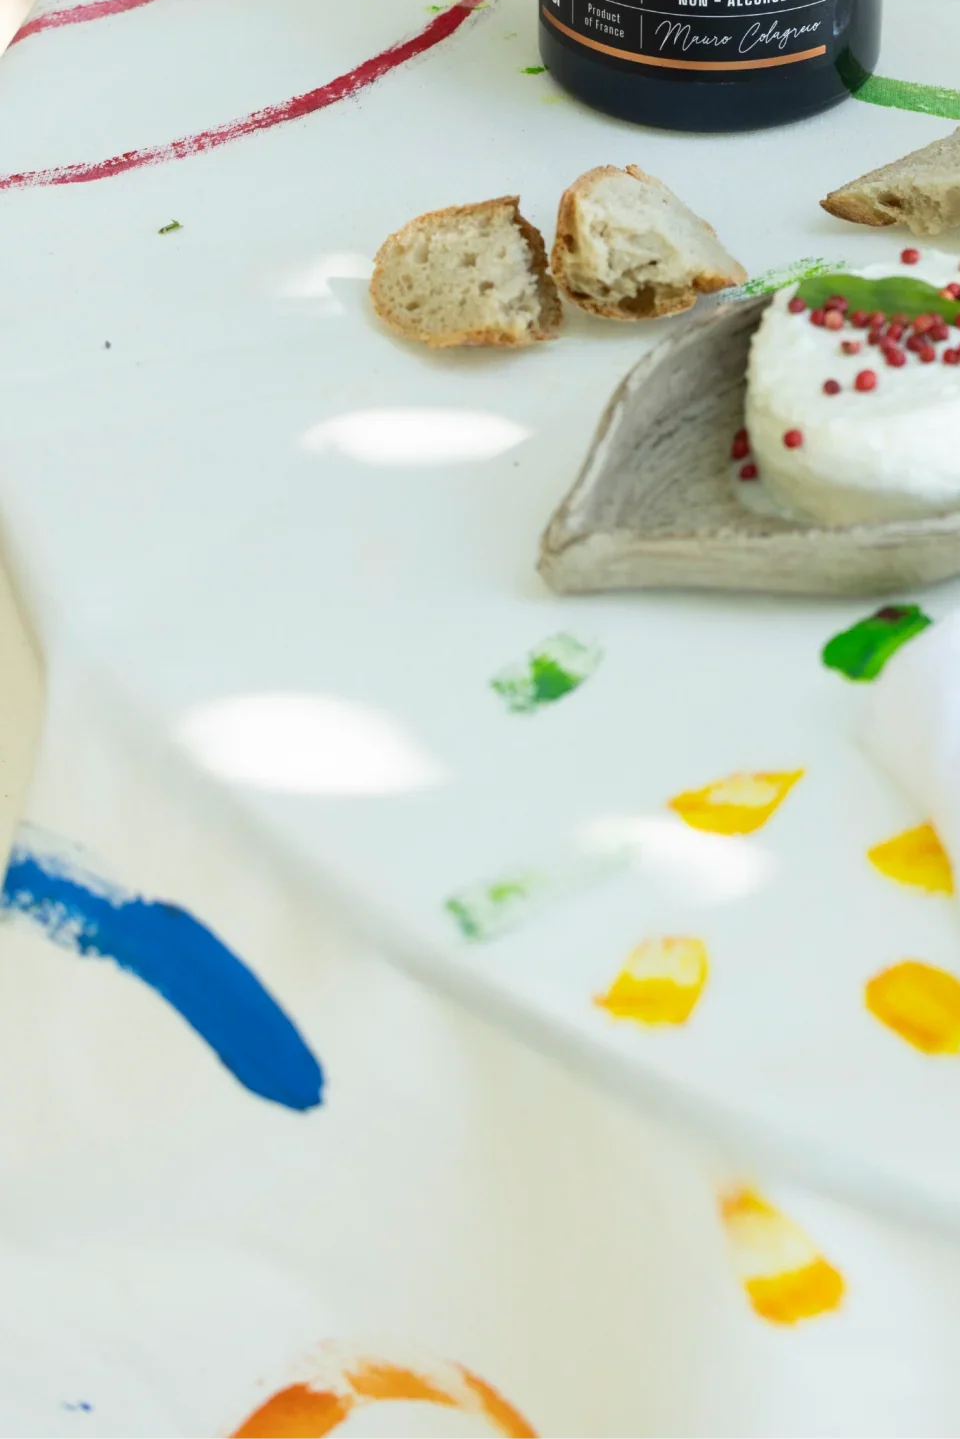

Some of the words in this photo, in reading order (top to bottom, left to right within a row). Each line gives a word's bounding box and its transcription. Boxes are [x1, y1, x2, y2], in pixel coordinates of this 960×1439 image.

[588, 2, 620, 24] Product
[584, 17, 592, 27] of
[595, 19, 625, 38] France
[655, 20, 732, 51] Mauro
[738, 20, 822, 53] Colagreco
